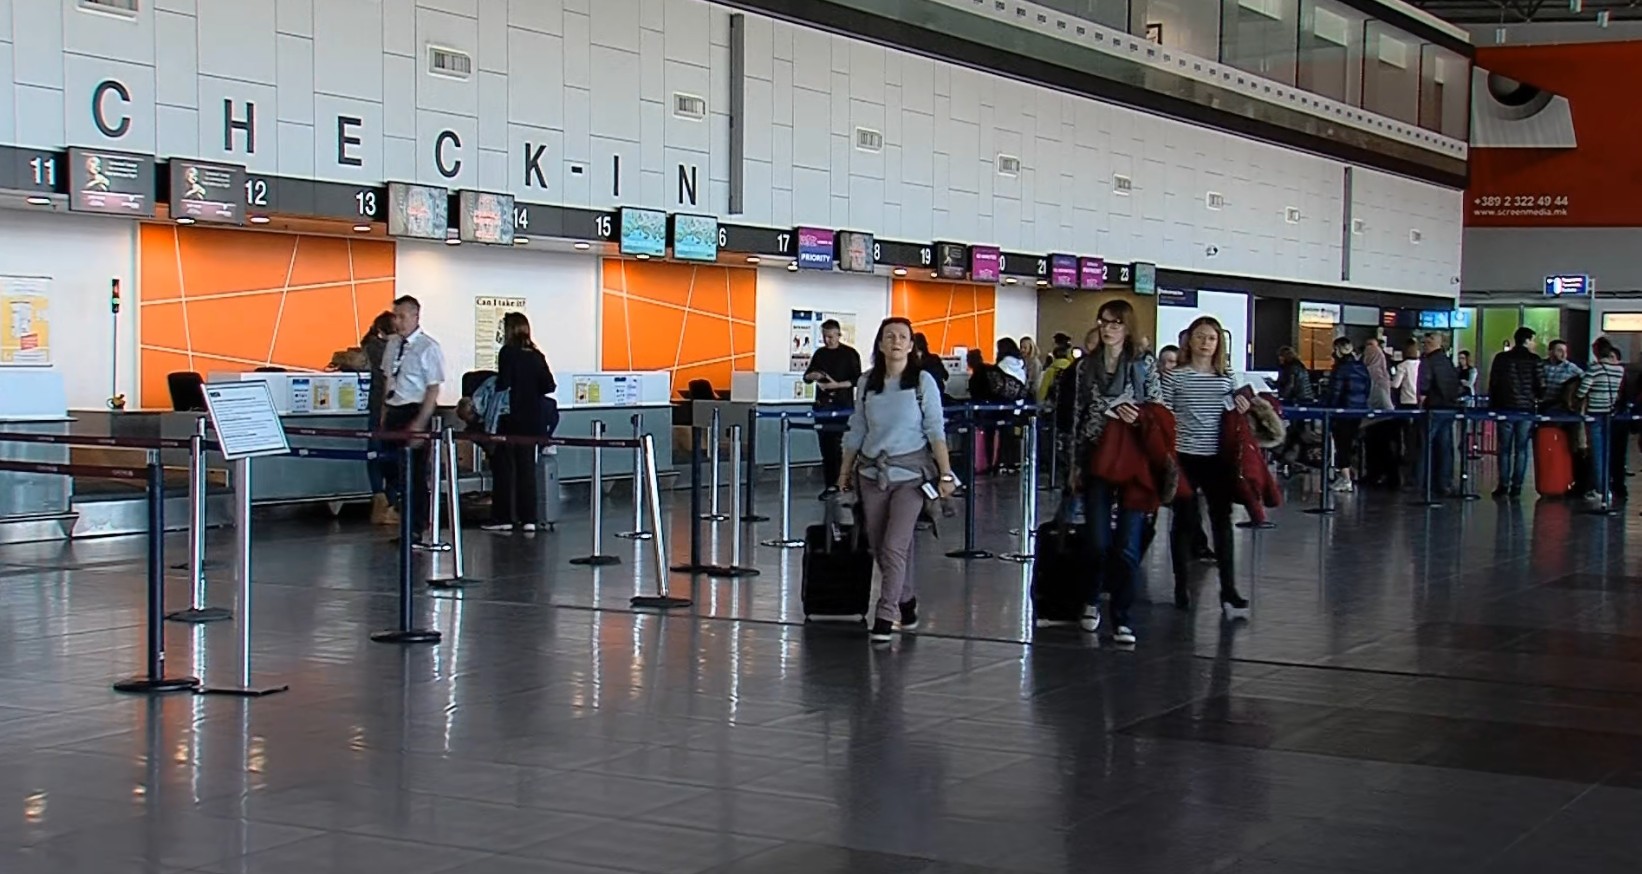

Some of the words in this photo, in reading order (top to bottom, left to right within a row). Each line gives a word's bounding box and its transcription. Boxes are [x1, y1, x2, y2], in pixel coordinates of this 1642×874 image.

[30, 157, 55, 185] 11
[245, 180, 267, 205] 12
[1474, 196, 1501, 207] +389
[1504, 196, 1511, 206] 2
[1514, 196, 1534, 207] 322
[1537, 196, 1551, 206] 49
[1554, 196, 1568, 206] 44
[355, 191, 376, 216] 13
[1474, 208, 1567, 216] www.screenmedia.mk
[513, 208, 529, 229] 14
[595, 216, 611, 236] 15
[717, 228, 727, 247] 6
[777, 234, 790, 252] 17
[801, 253, 831, 263] PRIORITY
[920, 248, 931, 265] 19
[1038, 260, 1047, 274] 21
[1120, 267, 1130, 282] 23
